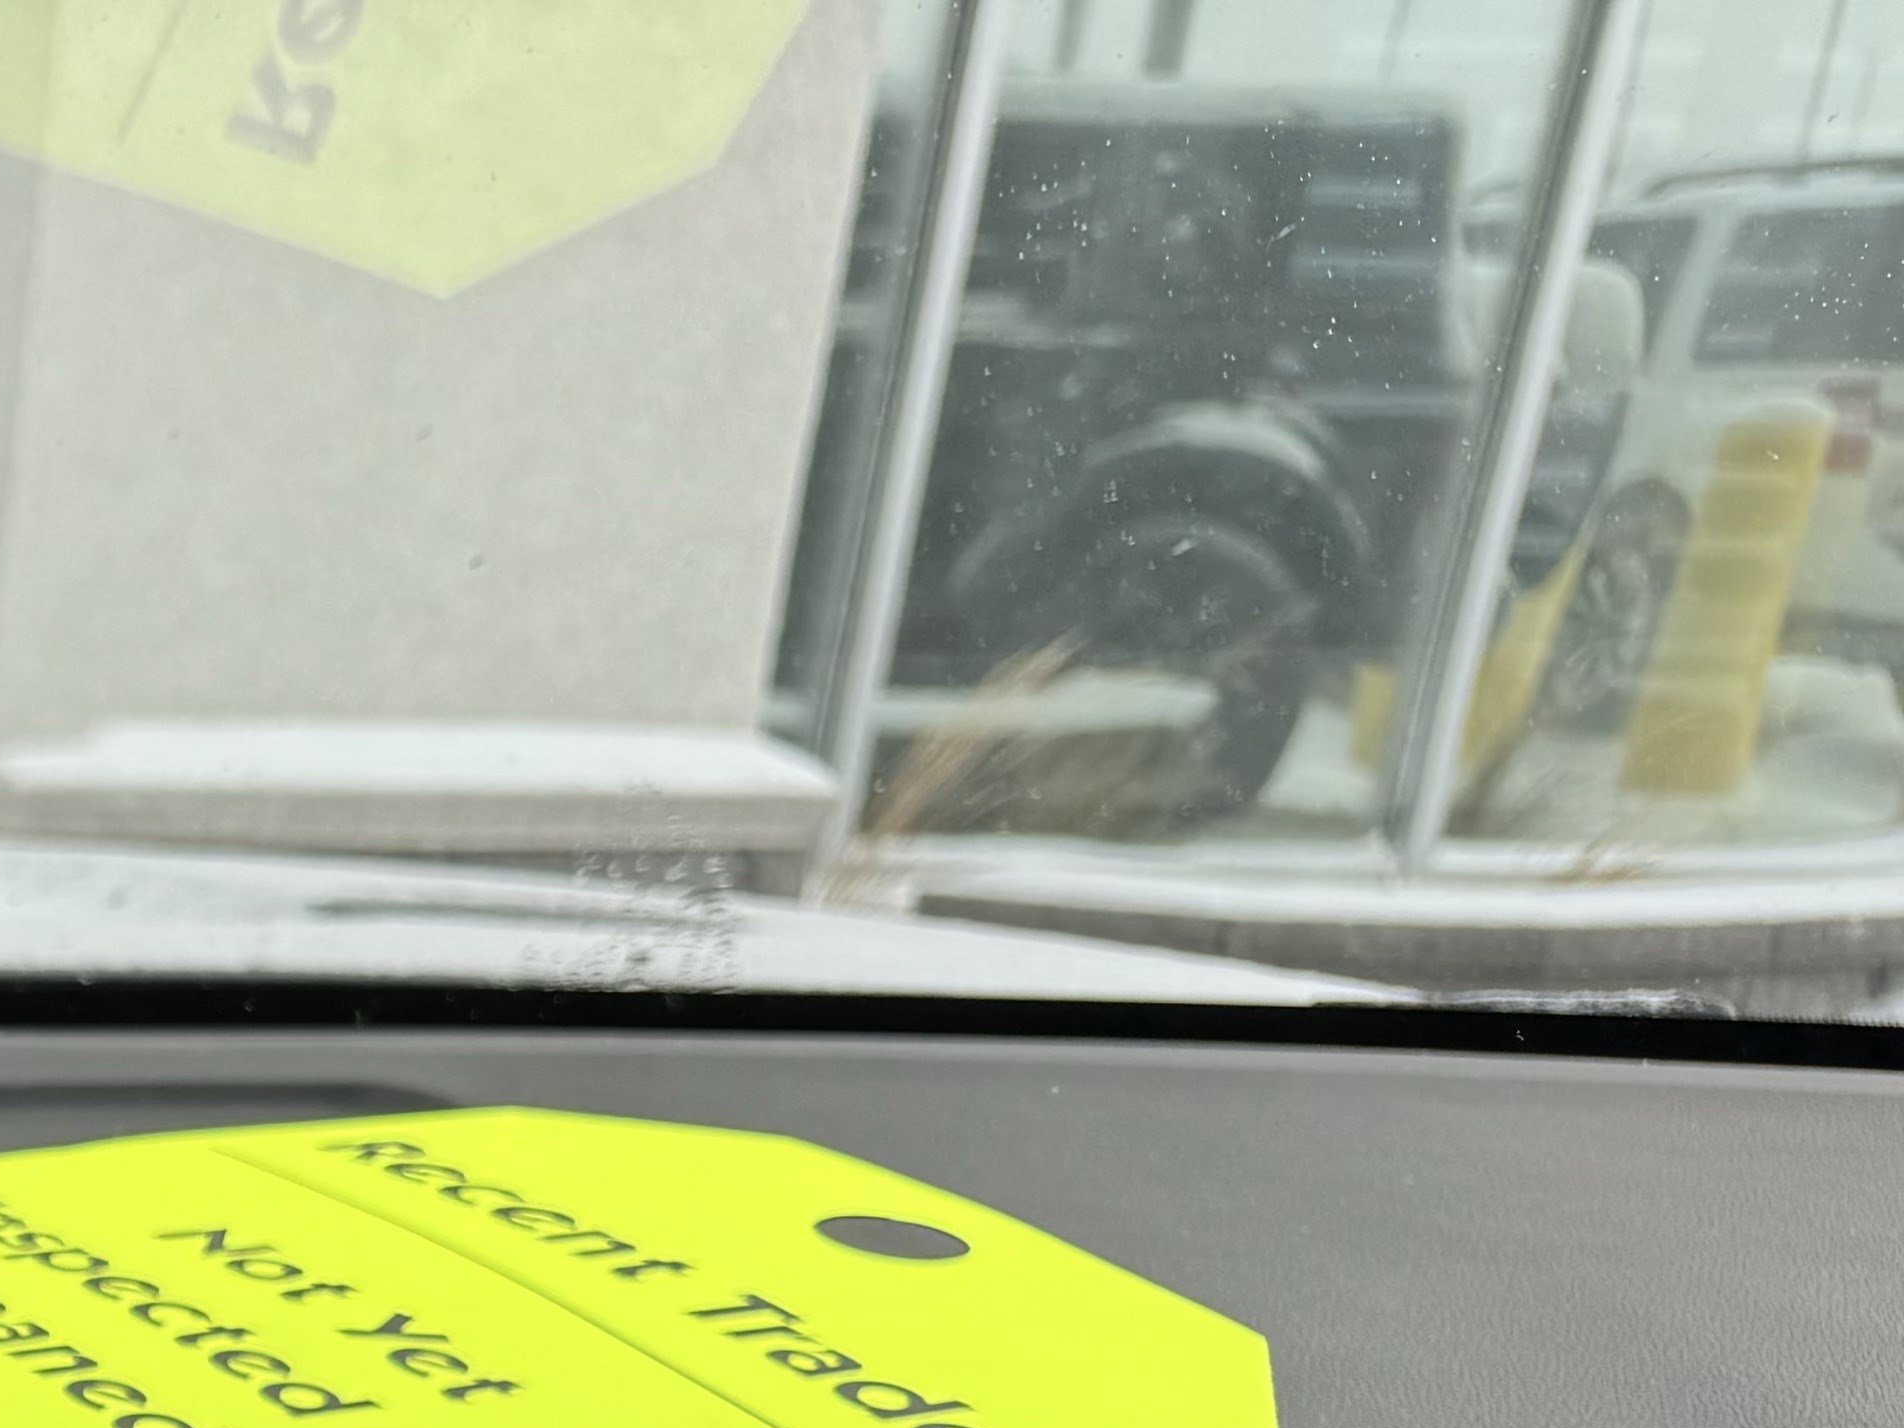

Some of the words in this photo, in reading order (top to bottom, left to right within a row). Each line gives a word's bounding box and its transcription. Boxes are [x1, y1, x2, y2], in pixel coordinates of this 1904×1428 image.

[317, 1139, 692, 1281] Recent
[150, 1228, 360, 1302] Not
[334, 1312, 524, 1404] Yet
